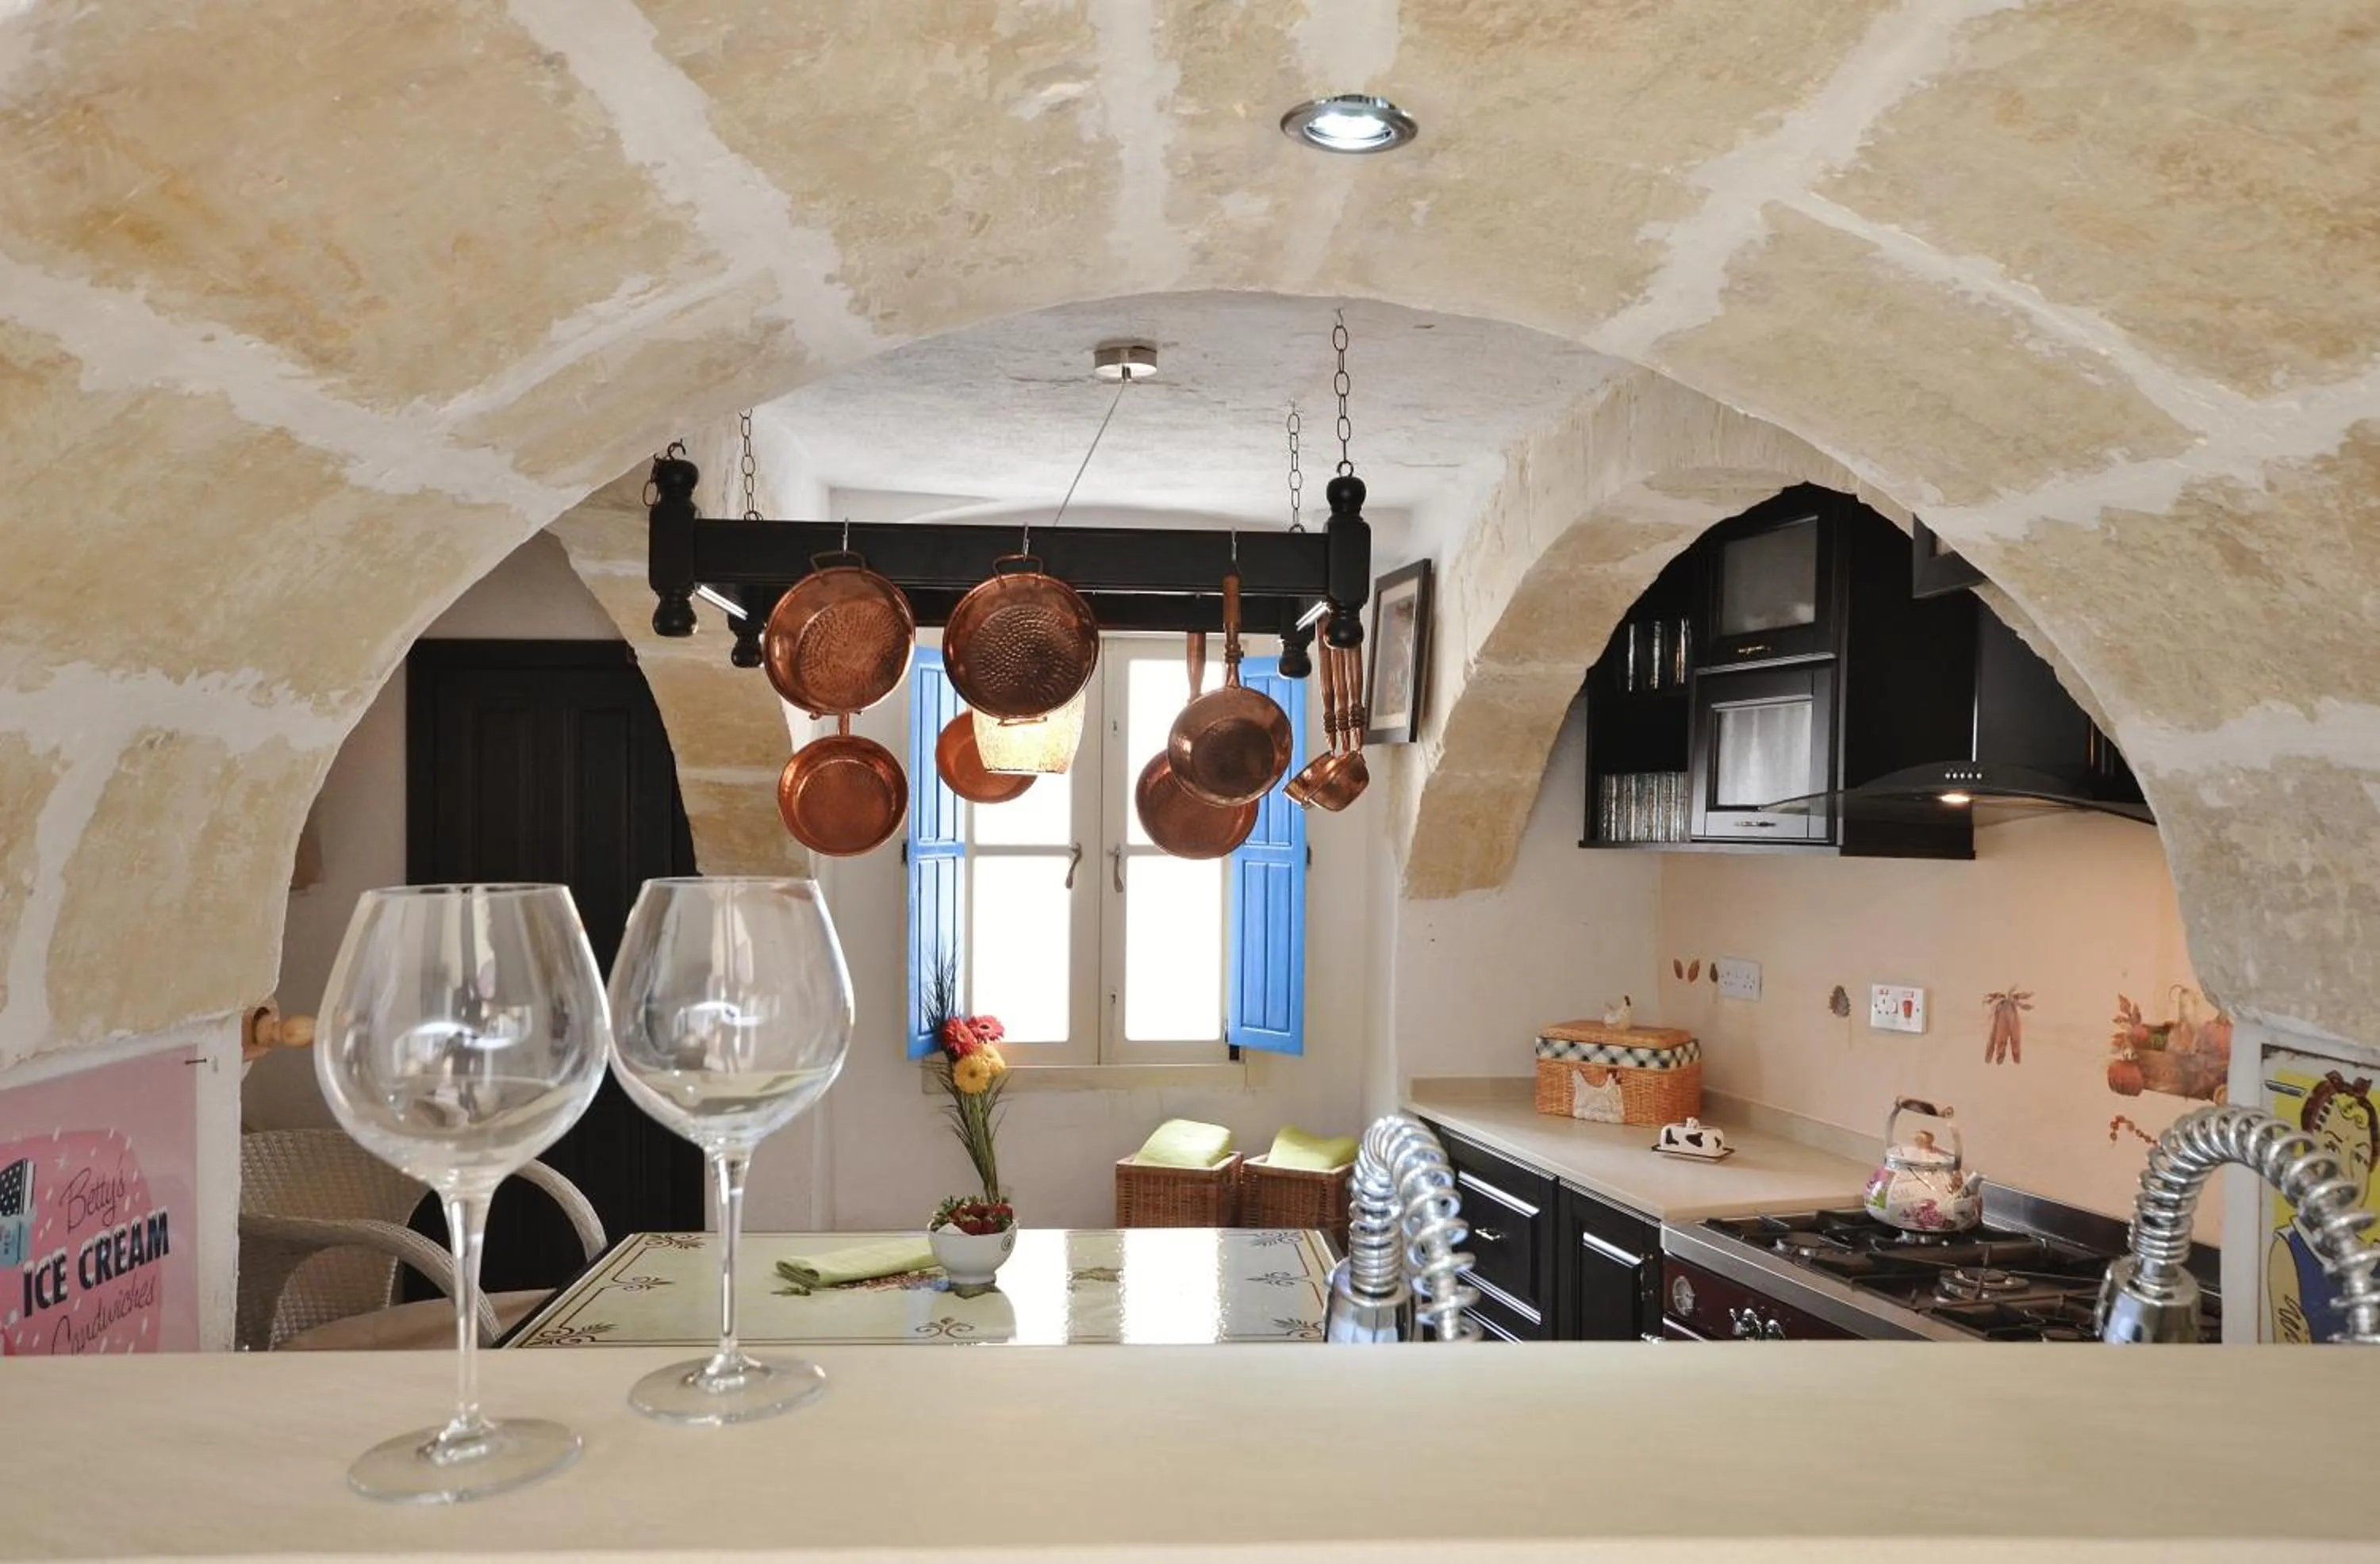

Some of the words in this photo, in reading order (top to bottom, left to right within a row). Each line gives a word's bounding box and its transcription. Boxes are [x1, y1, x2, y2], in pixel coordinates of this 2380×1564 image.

[59, 1154, 125, 1234] Betty's
[23, 1248, 68, 1318] ICE
[78, 1206, 169, 1290] CREAM
